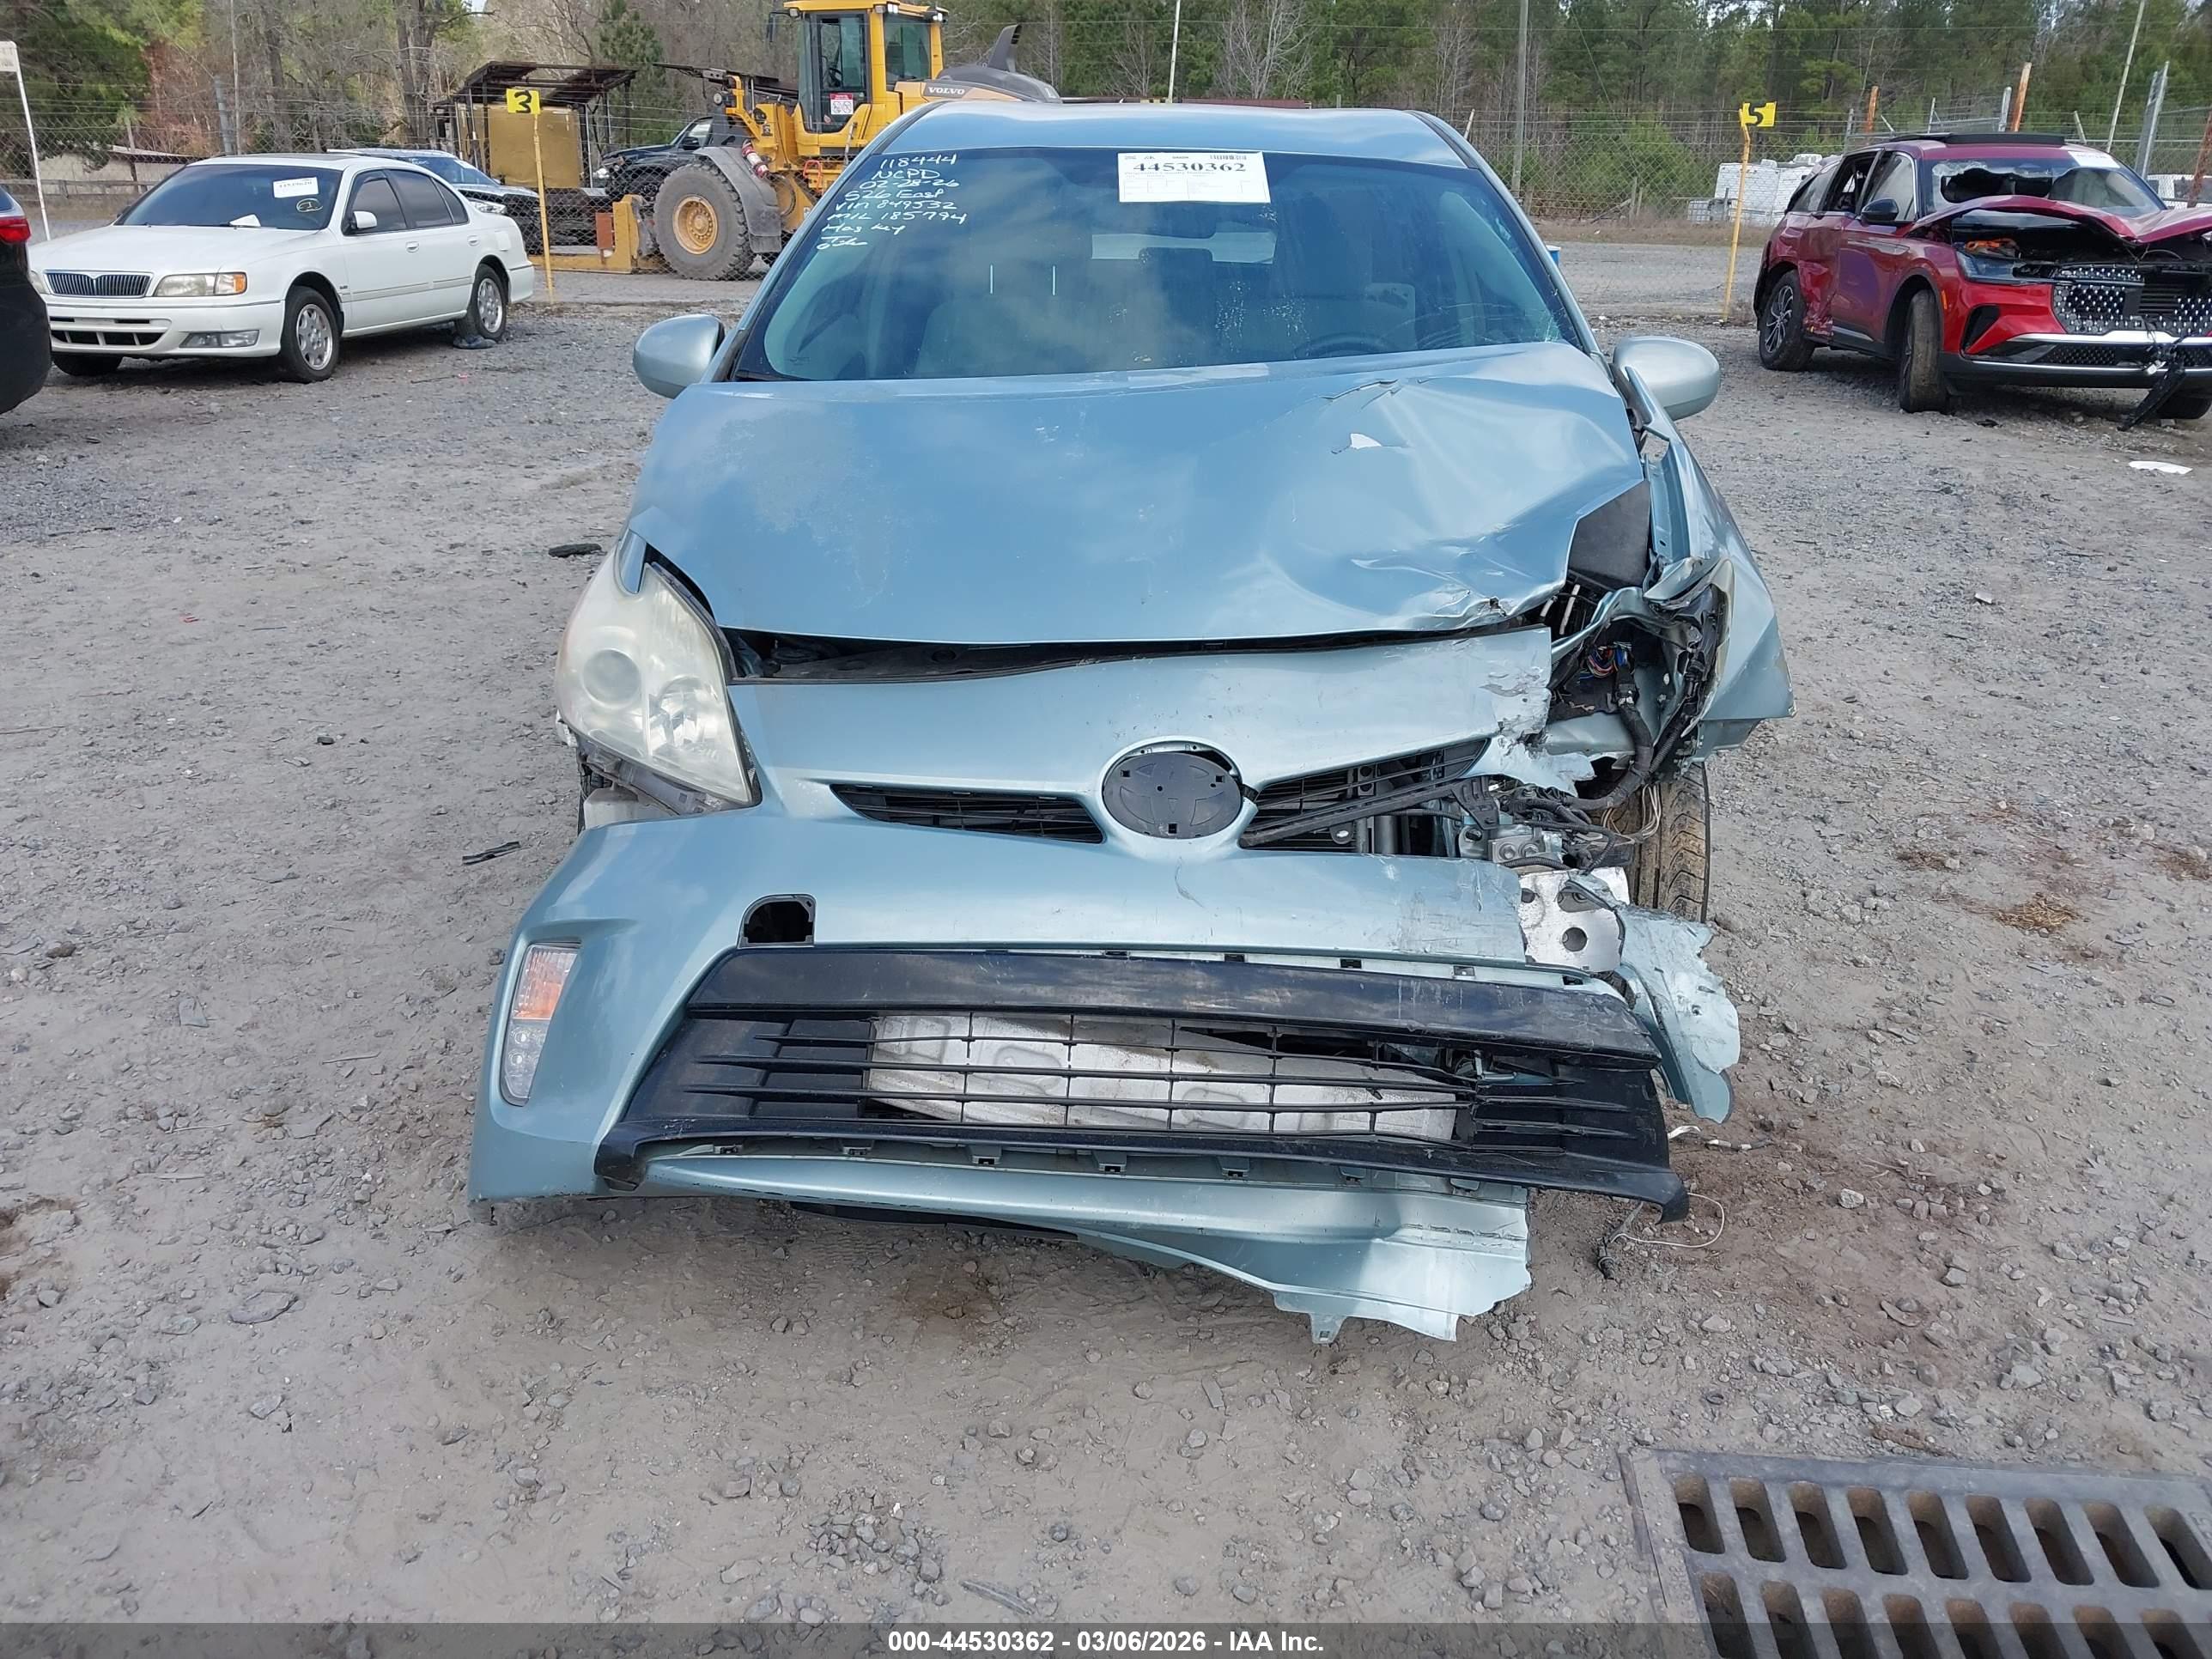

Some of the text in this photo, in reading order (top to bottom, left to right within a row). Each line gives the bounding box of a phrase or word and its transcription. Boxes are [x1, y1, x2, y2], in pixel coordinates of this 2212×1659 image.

[514, 89, 532, 113] 3
[1745, 102, 1767, 125] 5
[880, 154, 957, 169] 118444
[1133, 162, 1246, 172] 44530362
[871, 168, 941, 180] NCPD
[859, 179, 960, 189] 02-28-26
[877, 199, 957, 210] 849532
[880, 210, 968, 225] 185794
